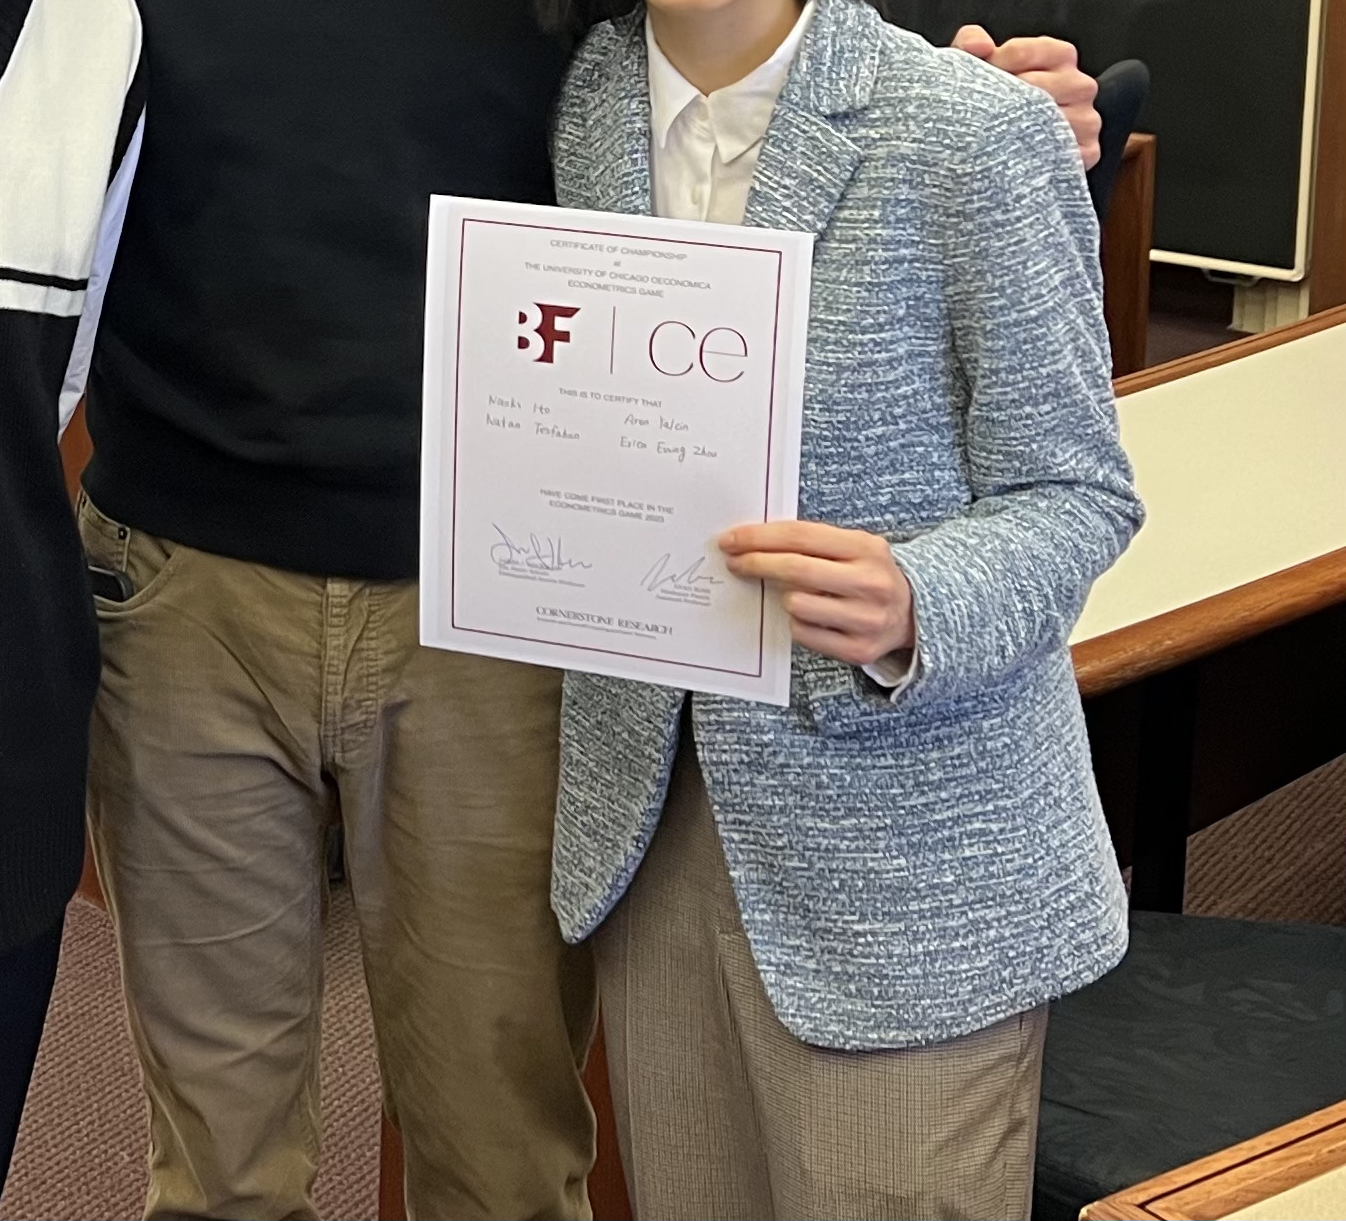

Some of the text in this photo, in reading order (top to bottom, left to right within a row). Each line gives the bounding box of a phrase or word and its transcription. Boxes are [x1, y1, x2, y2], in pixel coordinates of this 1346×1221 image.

[550, 239, 688, 261] CERTIFICATE OF CHAMPIONSHIP
[524, 261, 711, 290] THE UNIVERSITY OF CHICAGO OECONOMICA
[568, 279, 664, 298] ECONOMETRICS GAME
[559, 387, 663, 409] THIS IS TO CERTIFY THAT
[540, 488, 674, 515] HAVE COME FIRST PLACE IN THE
[549, 499, 617, 516] ECONOMETRICS
[618, 509, 643, 520] GAME
[535, 606, 614, 626] CORNERSTONE
[617, 617, 673, 636] RESEARCH
